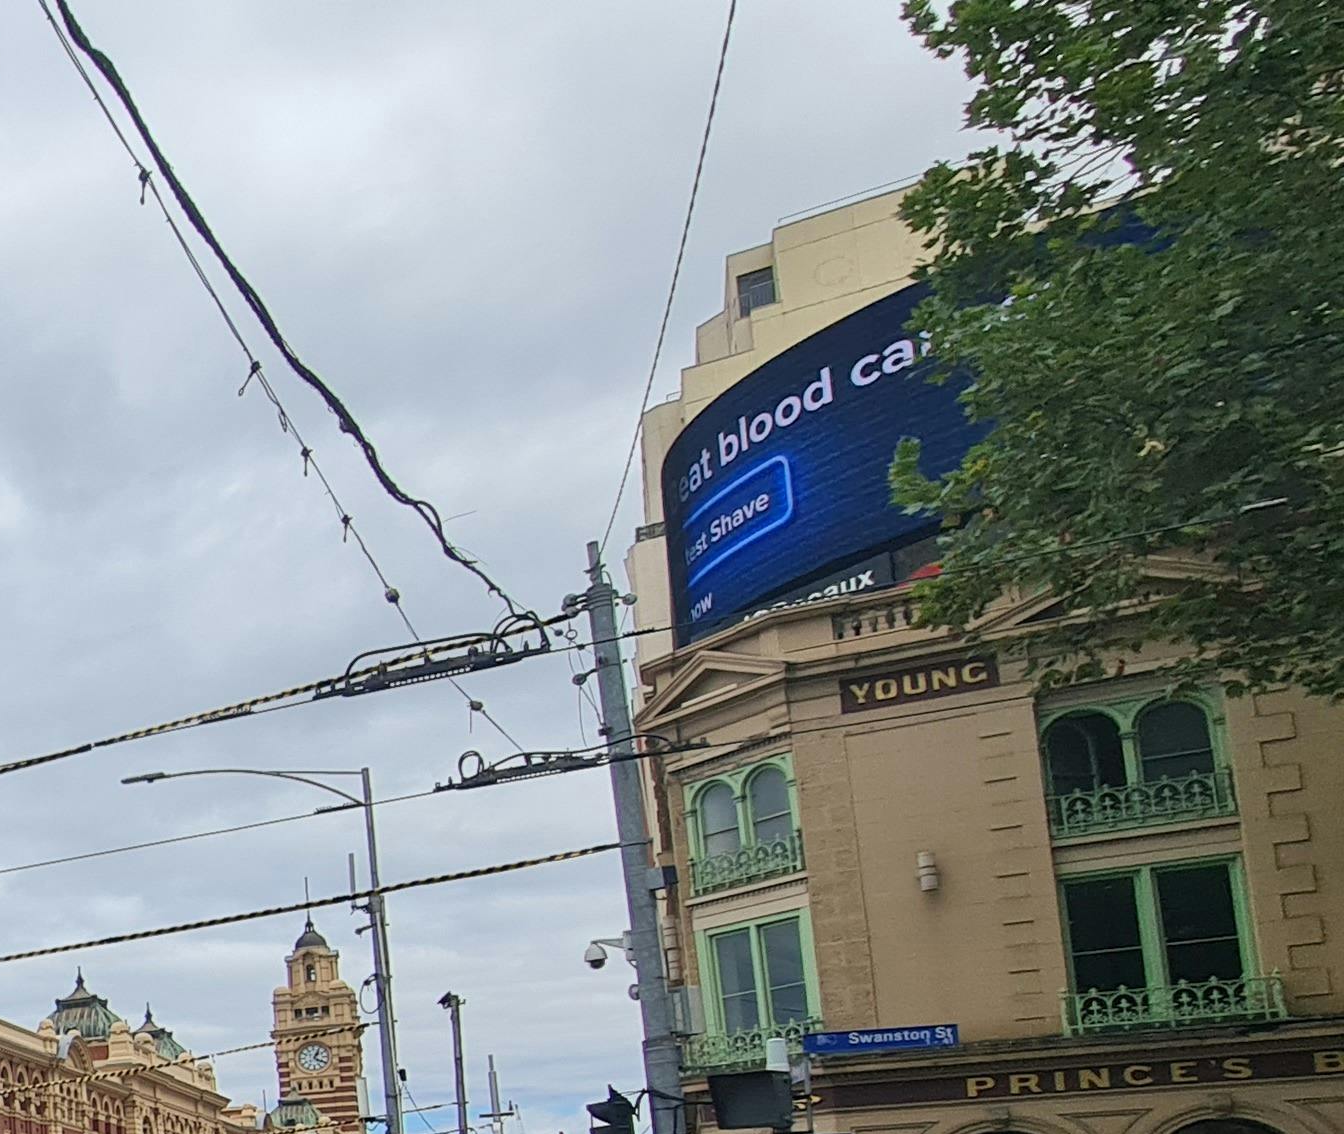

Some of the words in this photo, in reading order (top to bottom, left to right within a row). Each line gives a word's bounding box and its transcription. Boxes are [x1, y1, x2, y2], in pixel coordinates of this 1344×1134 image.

[718, 366, 834, 467] blood
[710, 493, 770, 542] Shave
[849, 662, 988, 704] YOUNG
[848, 1030, 931, 1045] Swanston
[934, 1026, 953, 1039] St
[965, 1057, 1254, 1098] PRINCE'S
